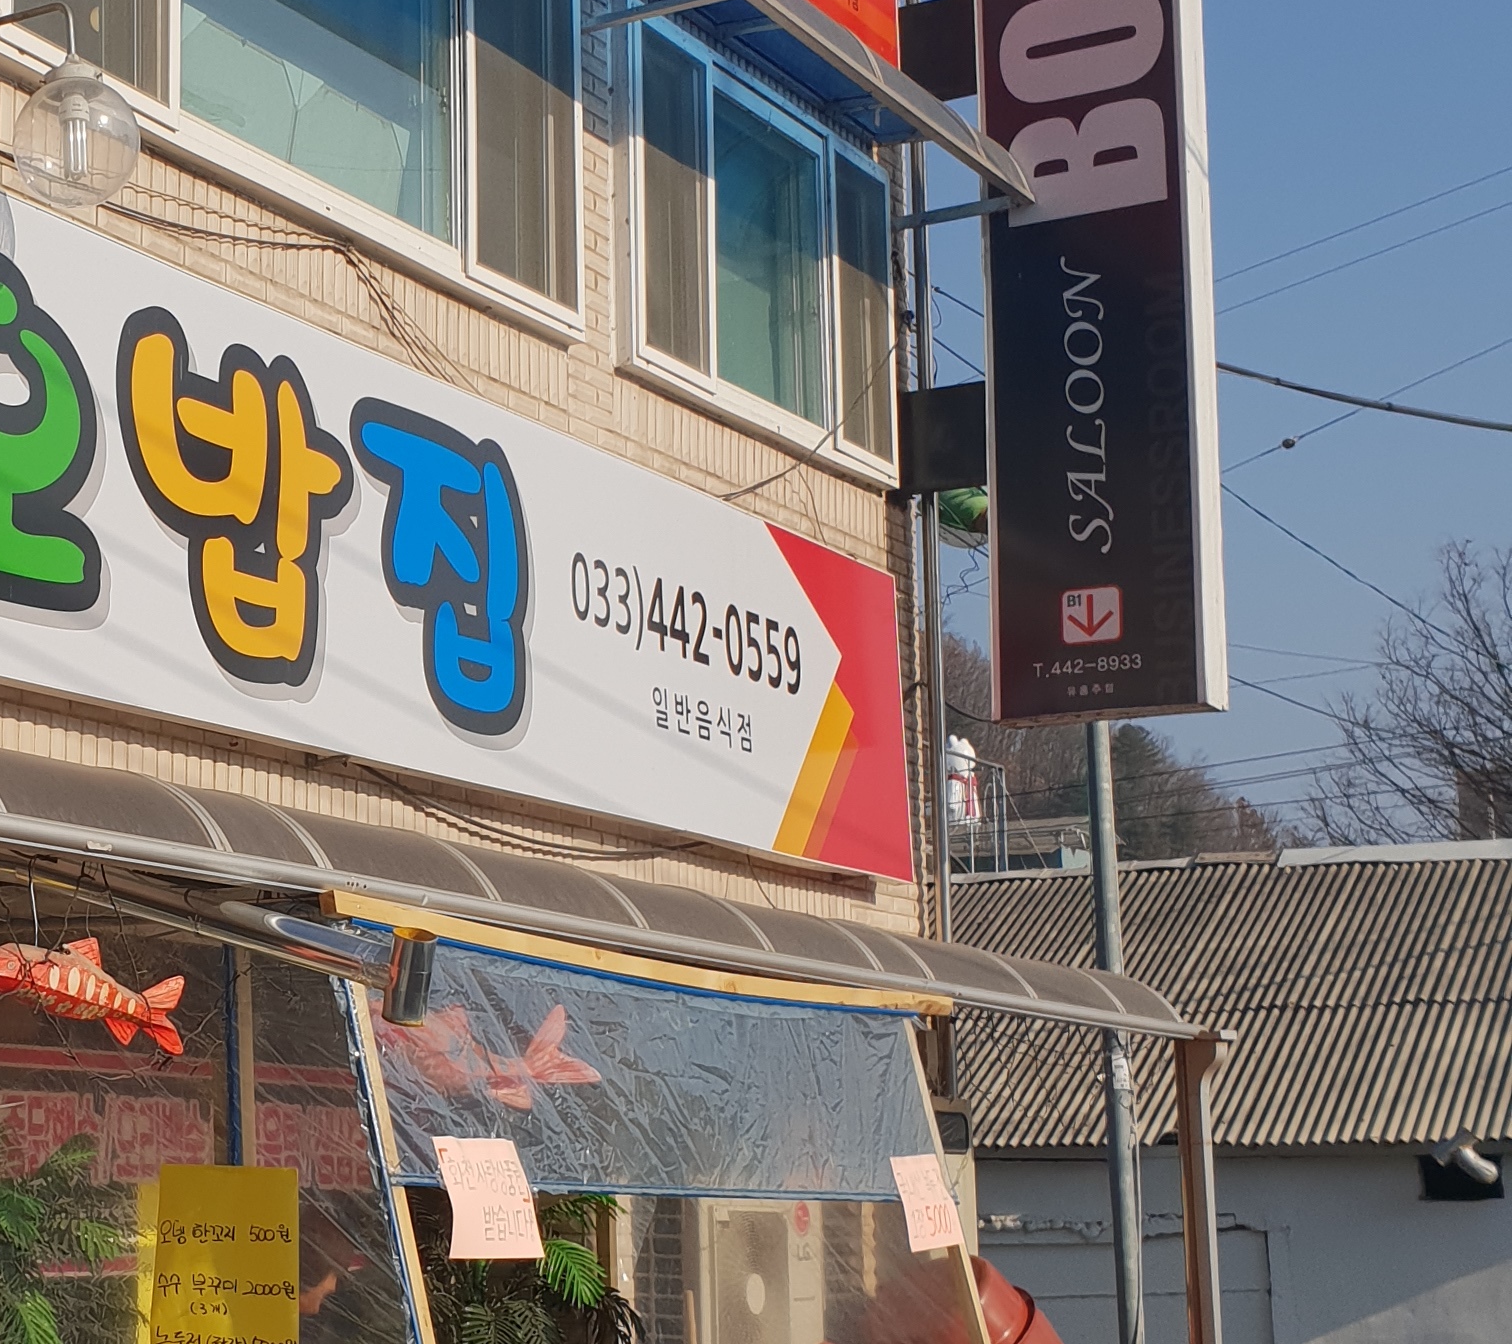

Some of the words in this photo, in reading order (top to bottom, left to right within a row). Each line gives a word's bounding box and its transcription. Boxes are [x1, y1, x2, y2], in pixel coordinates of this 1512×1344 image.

[1064, 257, 1110, 555] SALOON
[1066, 594, 1082, 607] B1
[571, 552, 801, 695] 033)442-0559
[1033, 654, 1143, 679] T.442-8933
[652, 686, 753, 753] 일반음식점
[249, 1223, 292, 1243] 500원
[925, 1203, 952, 1237] 5000
[158, 1272, 181, 1297] 수수
[192, 1273, 237, 1296] 부꾸미
[242, 1280, 296, 1300] 2000원
